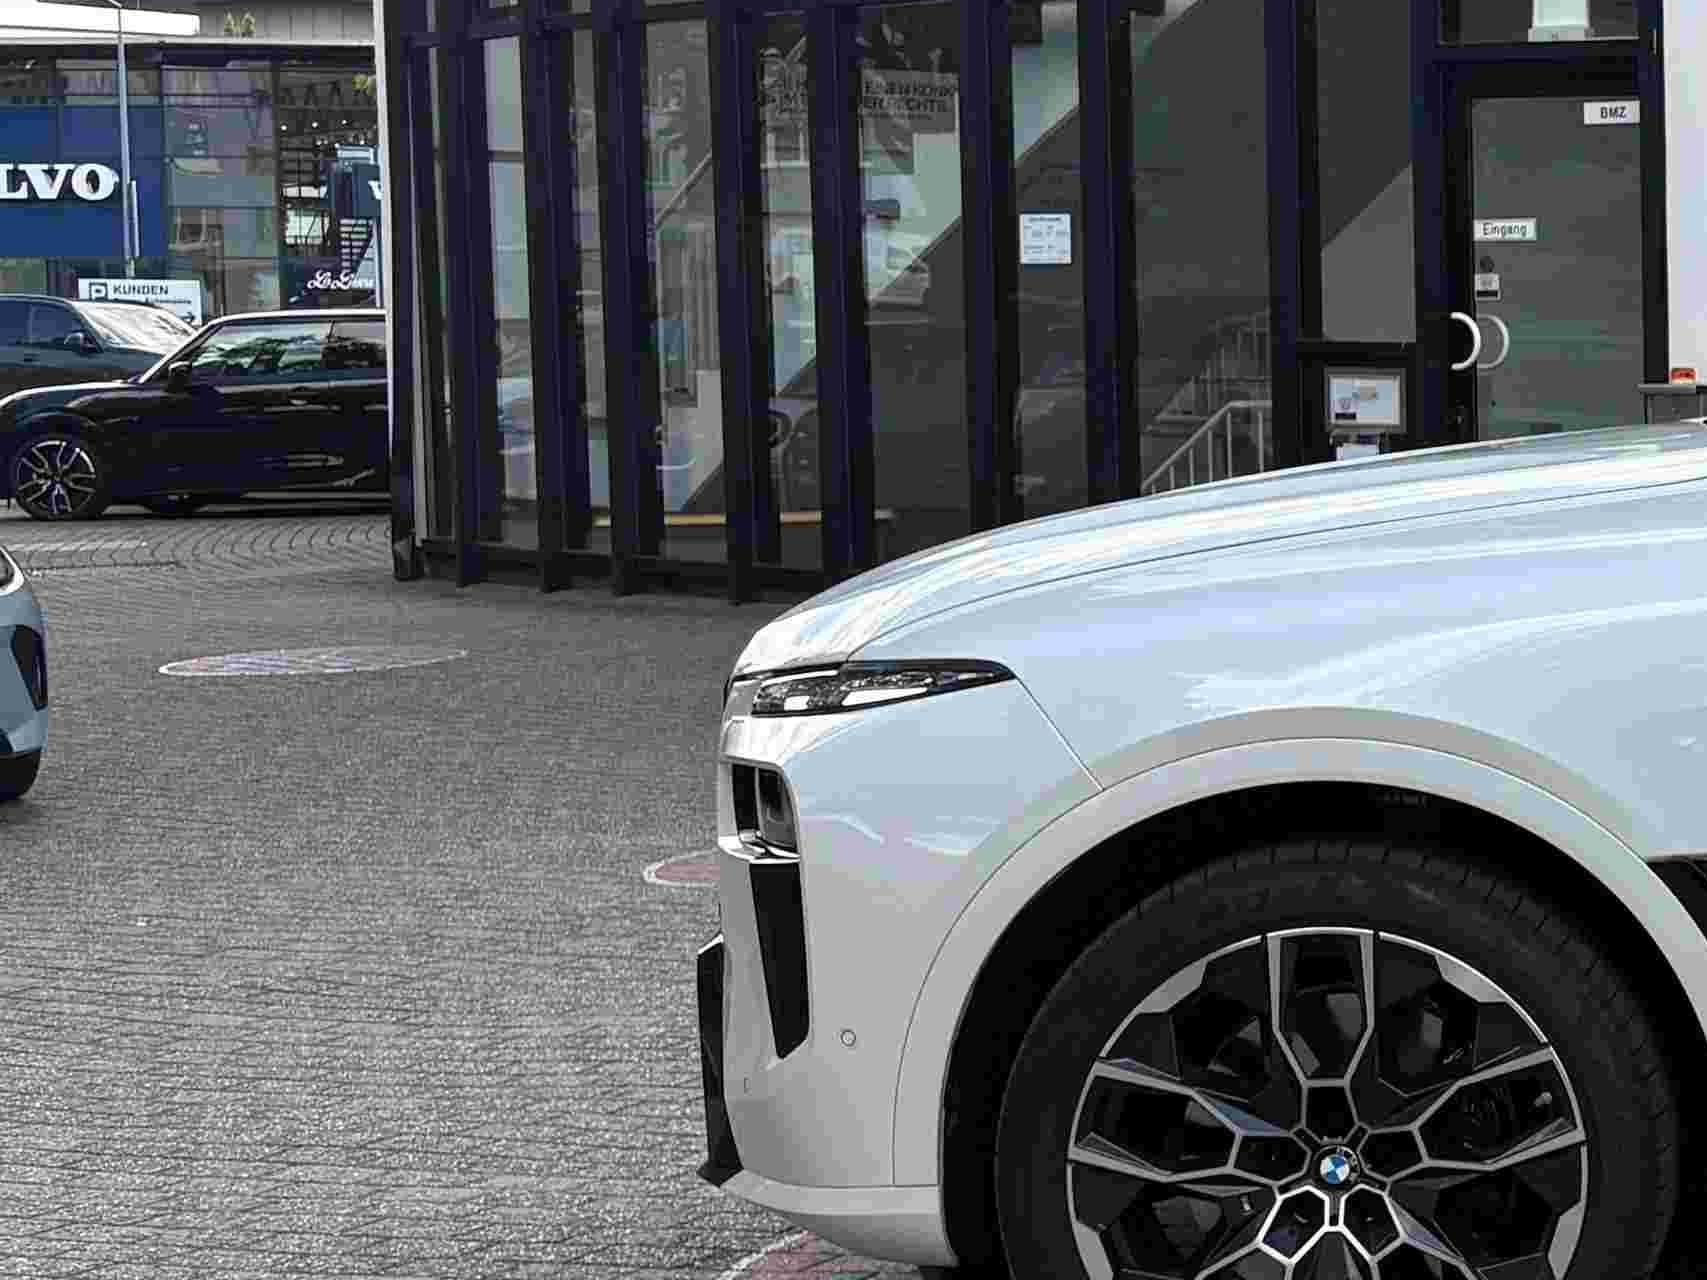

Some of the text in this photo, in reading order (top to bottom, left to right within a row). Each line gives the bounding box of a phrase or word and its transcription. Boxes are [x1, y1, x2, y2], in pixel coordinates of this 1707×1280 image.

[1599, 106, 1628, 119] BMZ
[1482, 222, 1528, 237] Eingang
[112, 284, 169, 296] KUNDEN
